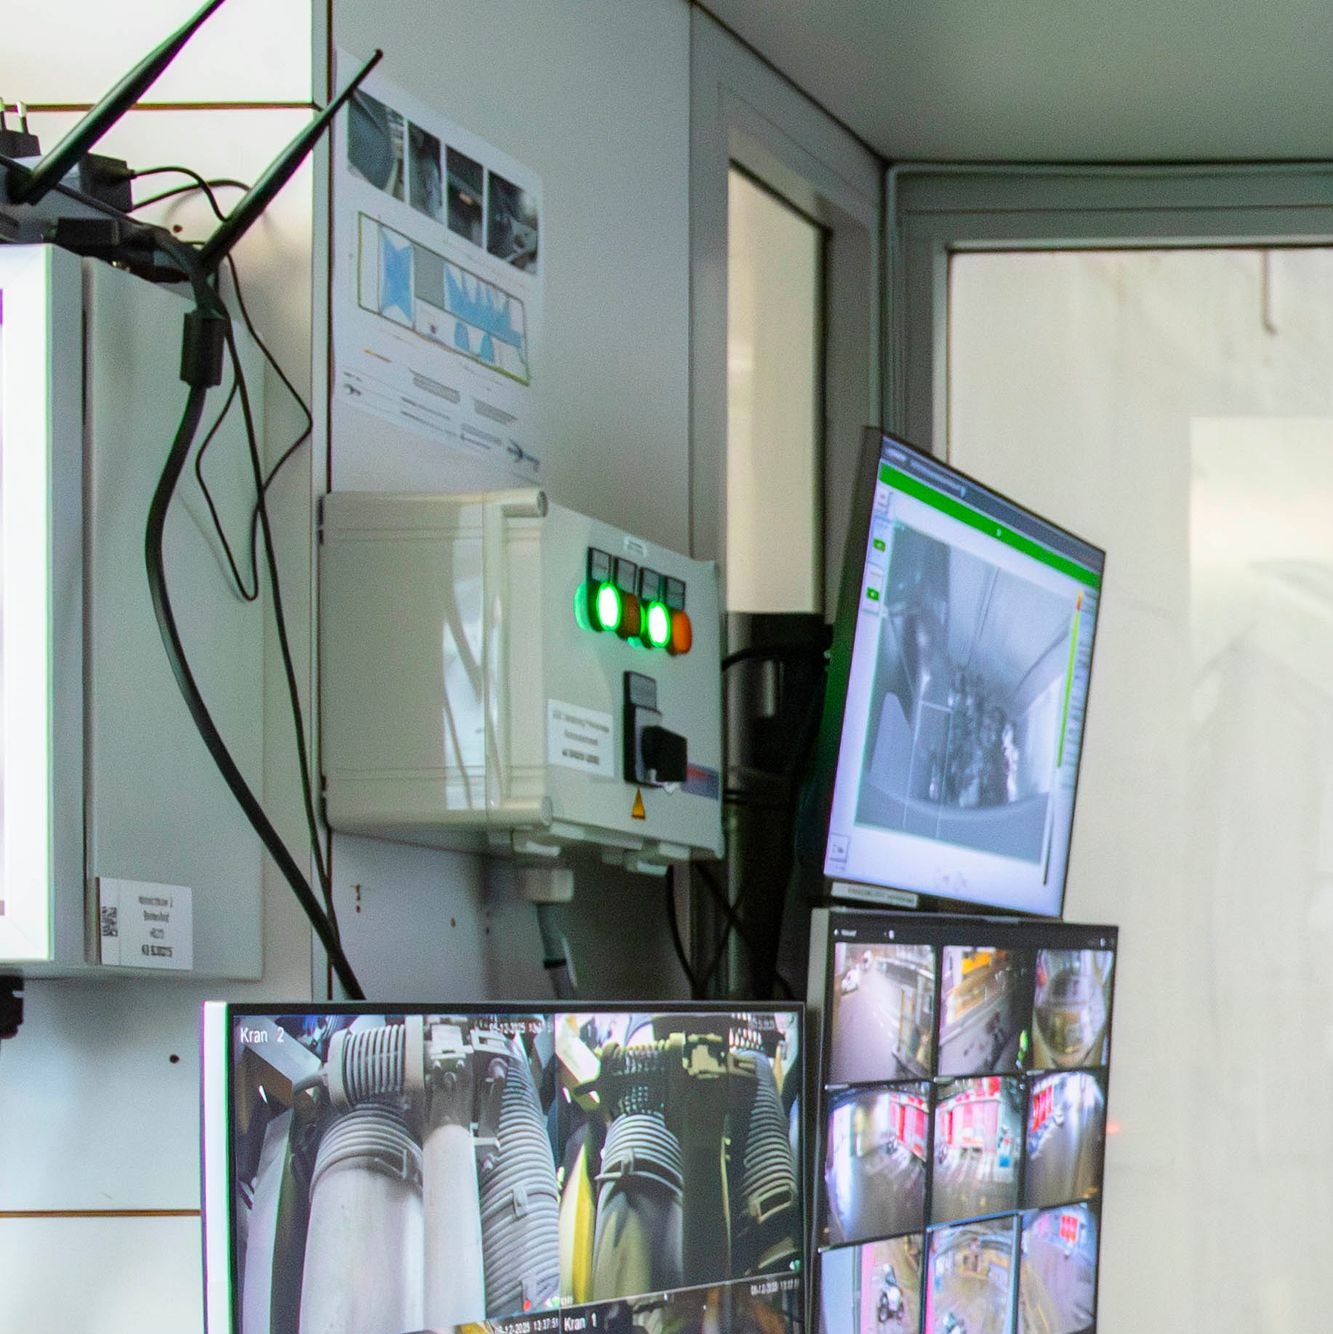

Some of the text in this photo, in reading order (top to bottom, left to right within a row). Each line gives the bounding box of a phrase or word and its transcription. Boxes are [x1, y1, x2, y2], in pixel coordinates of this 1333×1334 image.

[240, 1026, 284, 1043] Kran 2
[563, 1311, 597, 1332] Kran 1
